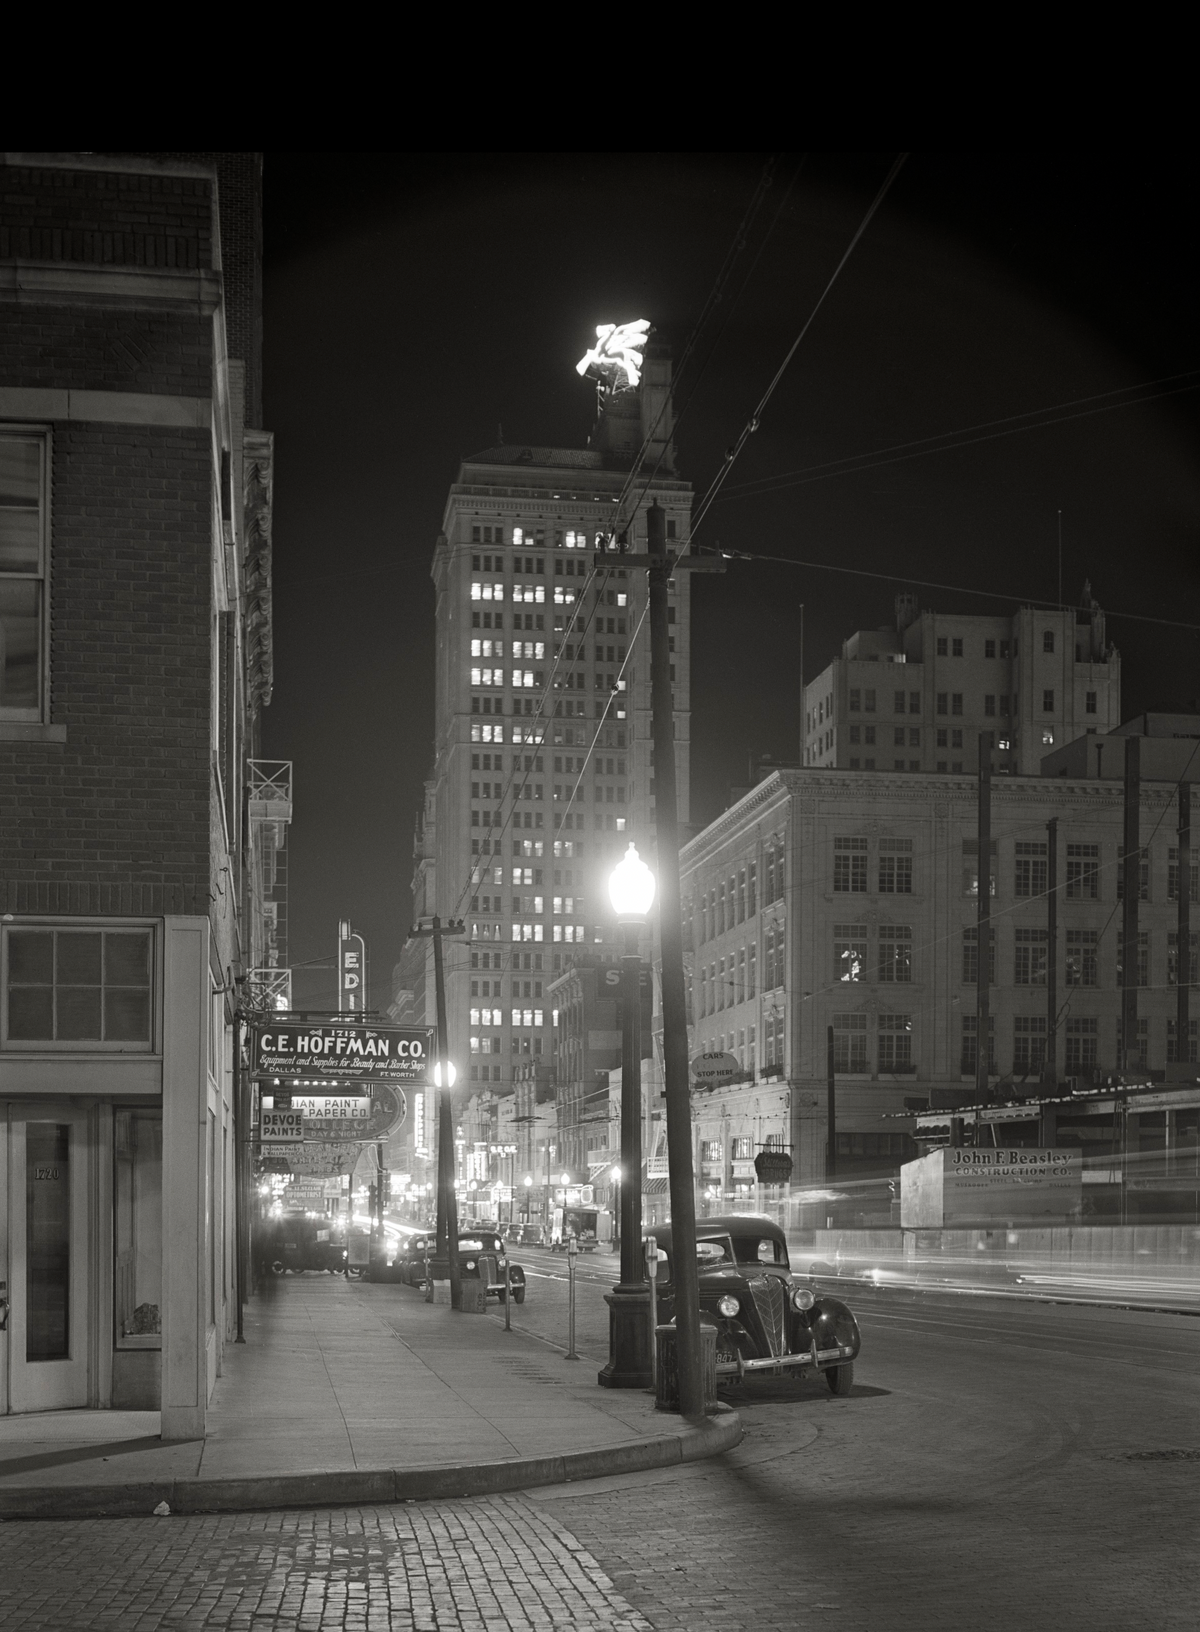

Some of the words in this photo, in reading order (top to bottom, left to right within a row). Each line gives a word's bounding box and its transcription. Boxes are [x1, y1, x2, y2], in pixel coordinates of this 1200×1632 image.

[331, 1029, 357, 1037] 1712
[261, 1034, 294, 1052] C.E.
[297, 1035, 389, 1056] HOFFMAN
[397, 1040, 426, 1058] CO.
[260, 1054, 297, 1068] Equipment
[296, 1056, 312, 1065] and
[311, 1055, 339, 1068] Supplies
[339, 1057, 351, 1067] for
[350, 1057, 376, 1072] Beauty
[375, 1059, 390, 1069] and
[388, 1059, 410, 1070] Barber
[409, 1060, 426, 1072] Shops
[697, 1070, 715, 1078] STOP
[325, 1100, 360, 1108] PAINT
[352, 1109, 369, 1118] CO.
[263, 1114, 302, 1126] DEVOE
[308, 1118, 376, 1130] OLLEGE
[263, 1127, 302, 1136] PAINTS
[952, 1150, 991, 1165] John
[995, 1151, 1005, 1165] F.
[1008, 1150, 1073, 1166] Beasley
[35, 1168, 59, 1180] 1720
[955, 1167, 1046, 1176] CONSTRUCTION
[1052, 1167, 1072, 1176] CO.
